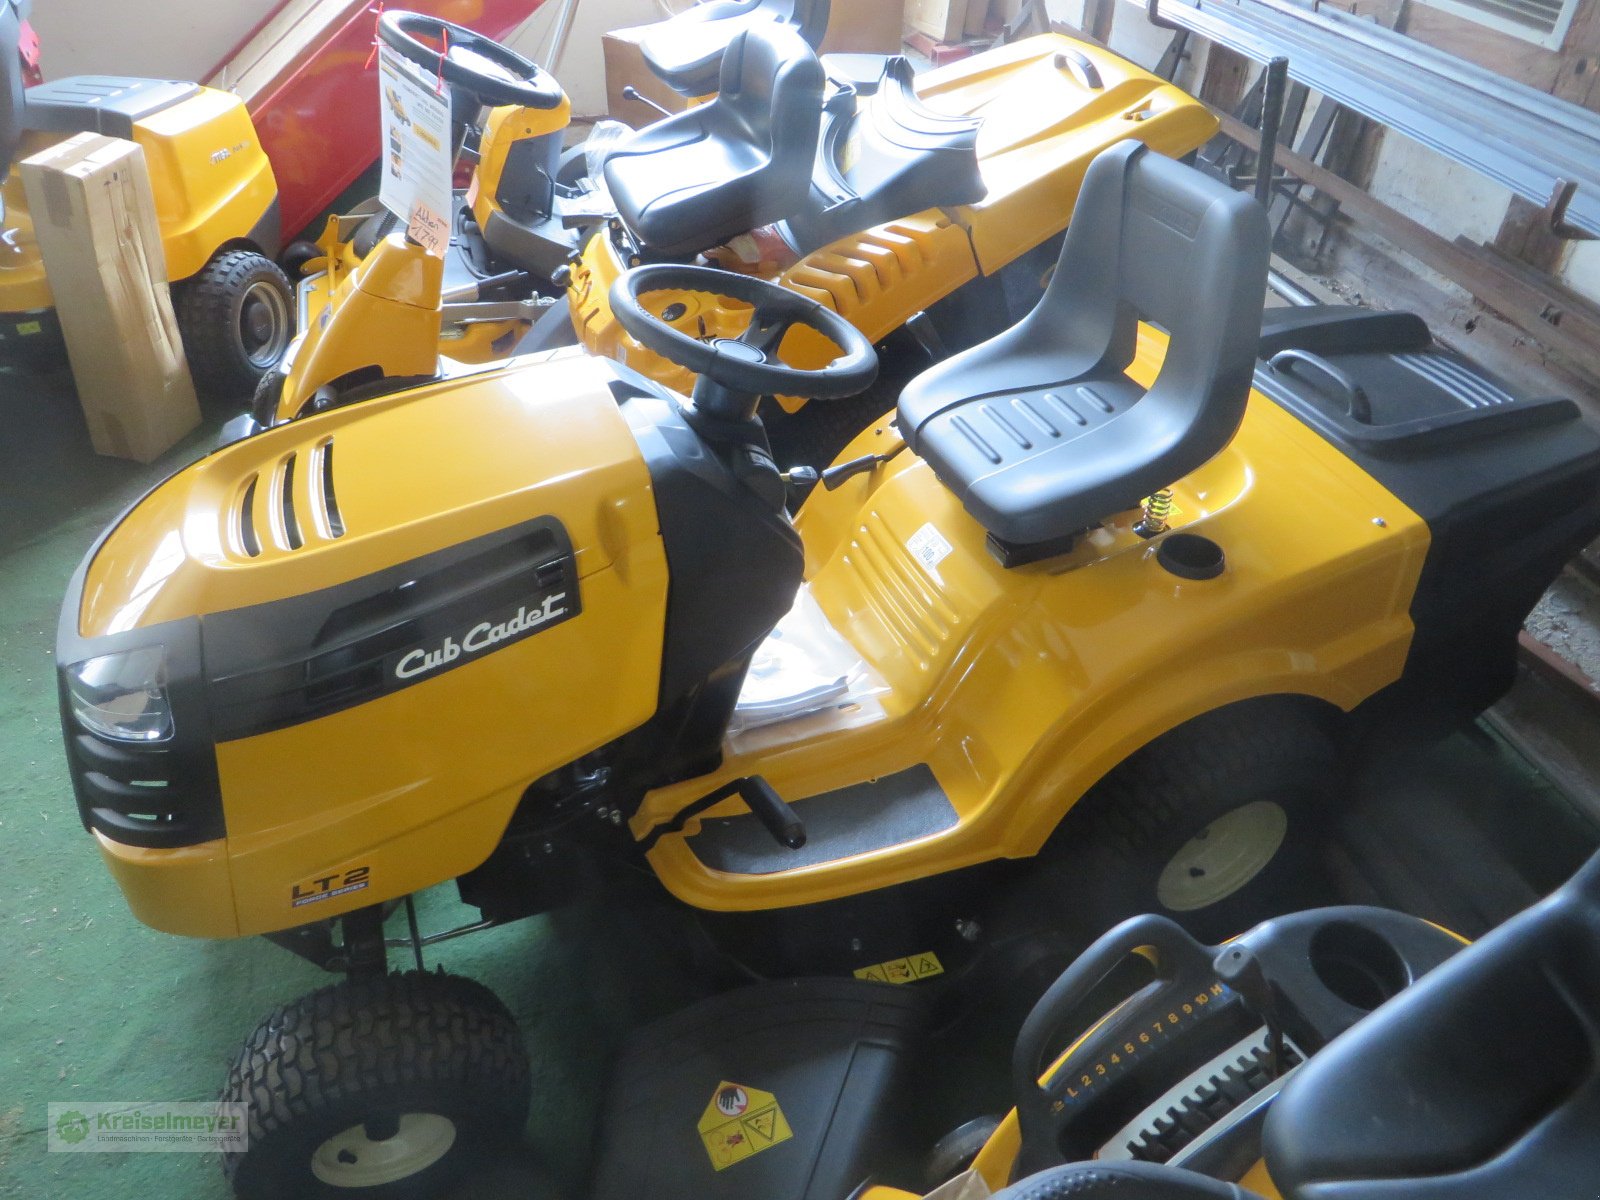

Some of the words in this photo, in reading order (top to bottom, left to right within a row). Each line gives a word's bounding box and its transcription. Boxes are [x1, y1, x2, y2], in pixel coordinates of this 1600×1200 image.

[395, 636, 461, 679] Cub
[462, 591, 566, 652] Cadet
[292, 866, 370, 900] LT2
[296, 891, 329, 906] FORCE
[331, 883, 367, 897] SERIES
[1081, 1075, 1092, 1086] 2
[1096, 1064, 1105, 1075] 3
[1111, 1053, 1120, 1063] 4
[1124, 1042, 1134, 1053] 5
[1139, 1032, 1149, 1043] 6
[1153, 1022, 1163, 1033] 7
[1168, 1013, 1178, 1024] 8
[1182, 1003, 1193, 1014] 9
[1195, 993, 1209, 1005] 10
[1210, 984, 1223, 996] H
